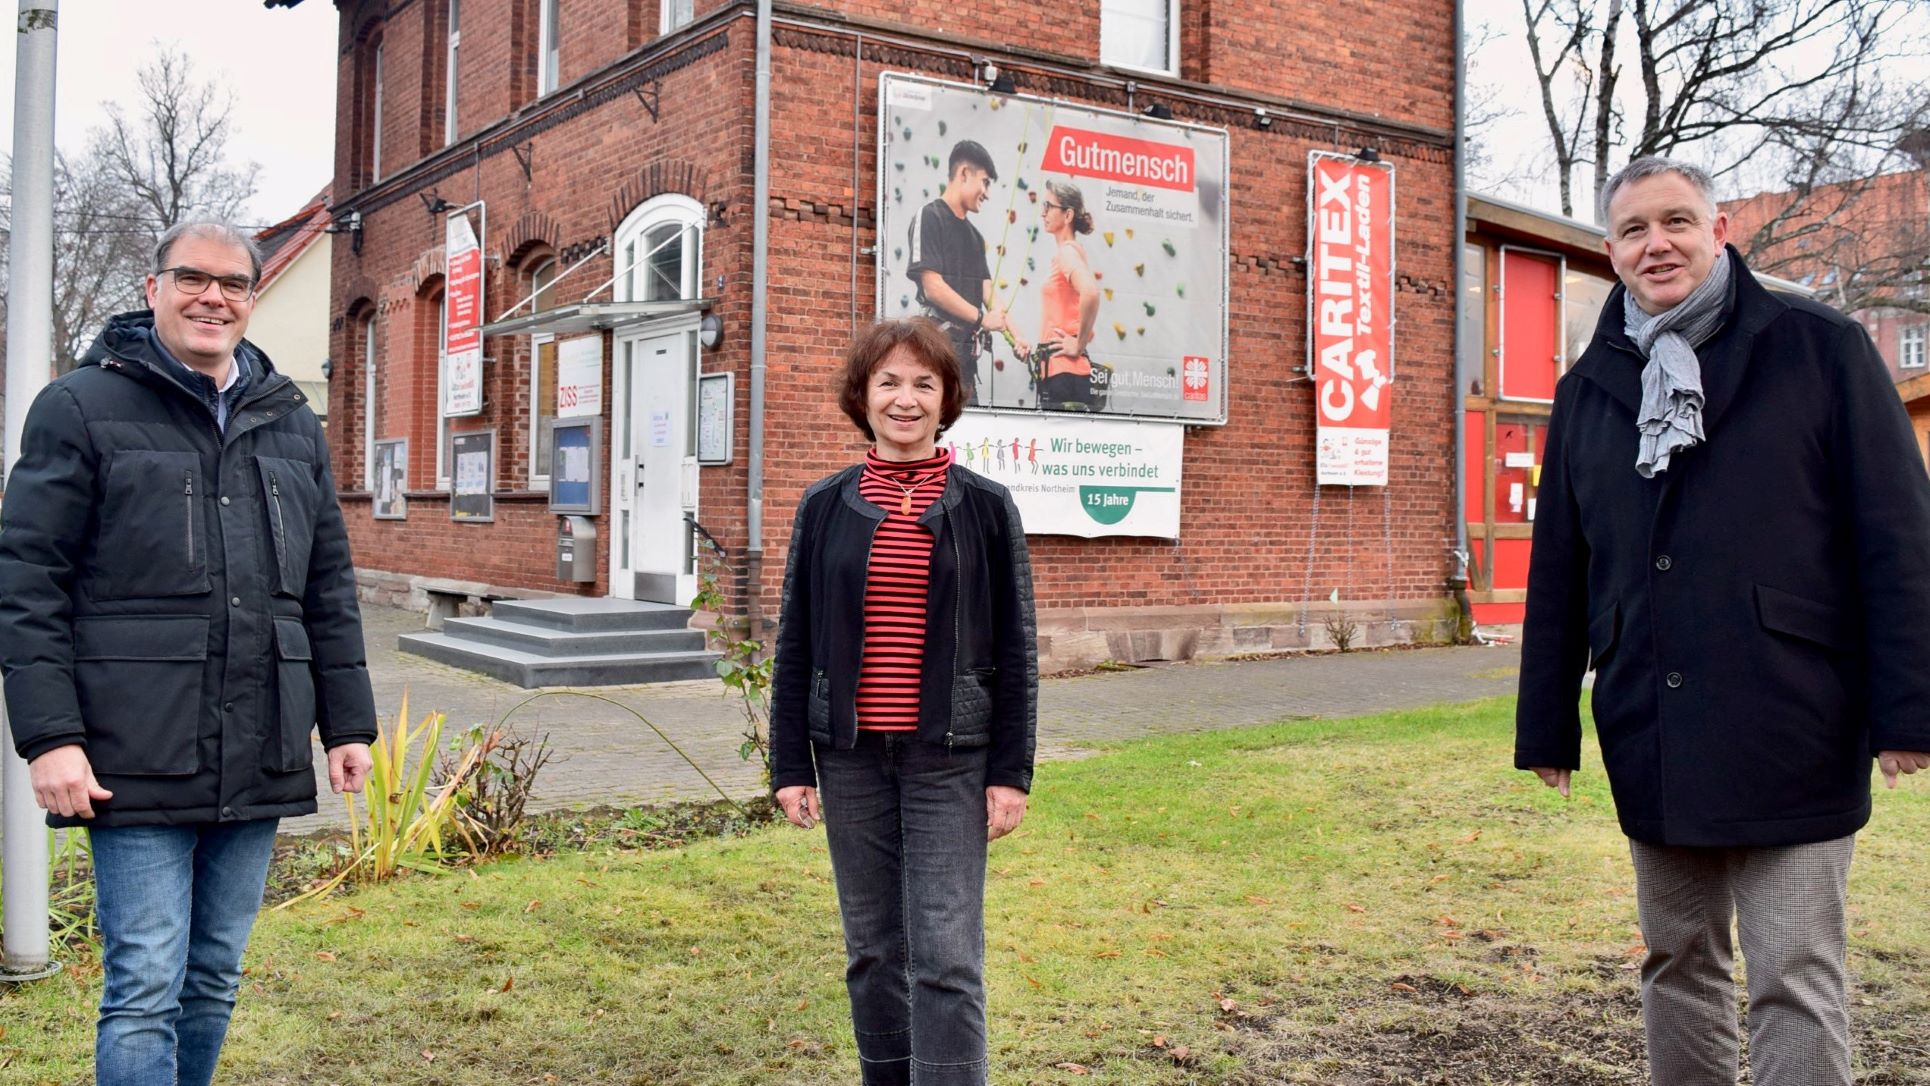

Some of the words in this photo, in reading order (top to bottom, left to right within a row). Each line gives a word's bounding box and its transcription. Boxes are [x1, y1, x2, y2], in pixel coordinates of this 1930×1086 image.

[1060, 136, 1188, 184] Gutmensch
[1106, 186, 1140, 201] Jemand,
[1141, 190, 1155, 202] der
[1106, 201, 1164, 217] Zusammenhalt
[1165, 210, 1194, 222] sichert.
[1355, 174, 1372, 335] Textil-Laden
[1320, 169, 1354, 422] CARITEX
[1089, 368, 1108, 384] Sei
[1132, 371, 1180, 389] Mensch!
[560, 386, 577, 408] ZISS
[1050, 438, 1072, 453] Wir
[1075, 438, 1132, 458] bewegen
[1042, 464, 1068, 476] was
[1072, 464, 1096, 477] uns
[1098, 463, 1159, 479] verbindet
[1041, 484, 1075, 494] Northeim
[1087, 493, 1101, 505] 15
[1103, 493, 1129, 507] Jahre
